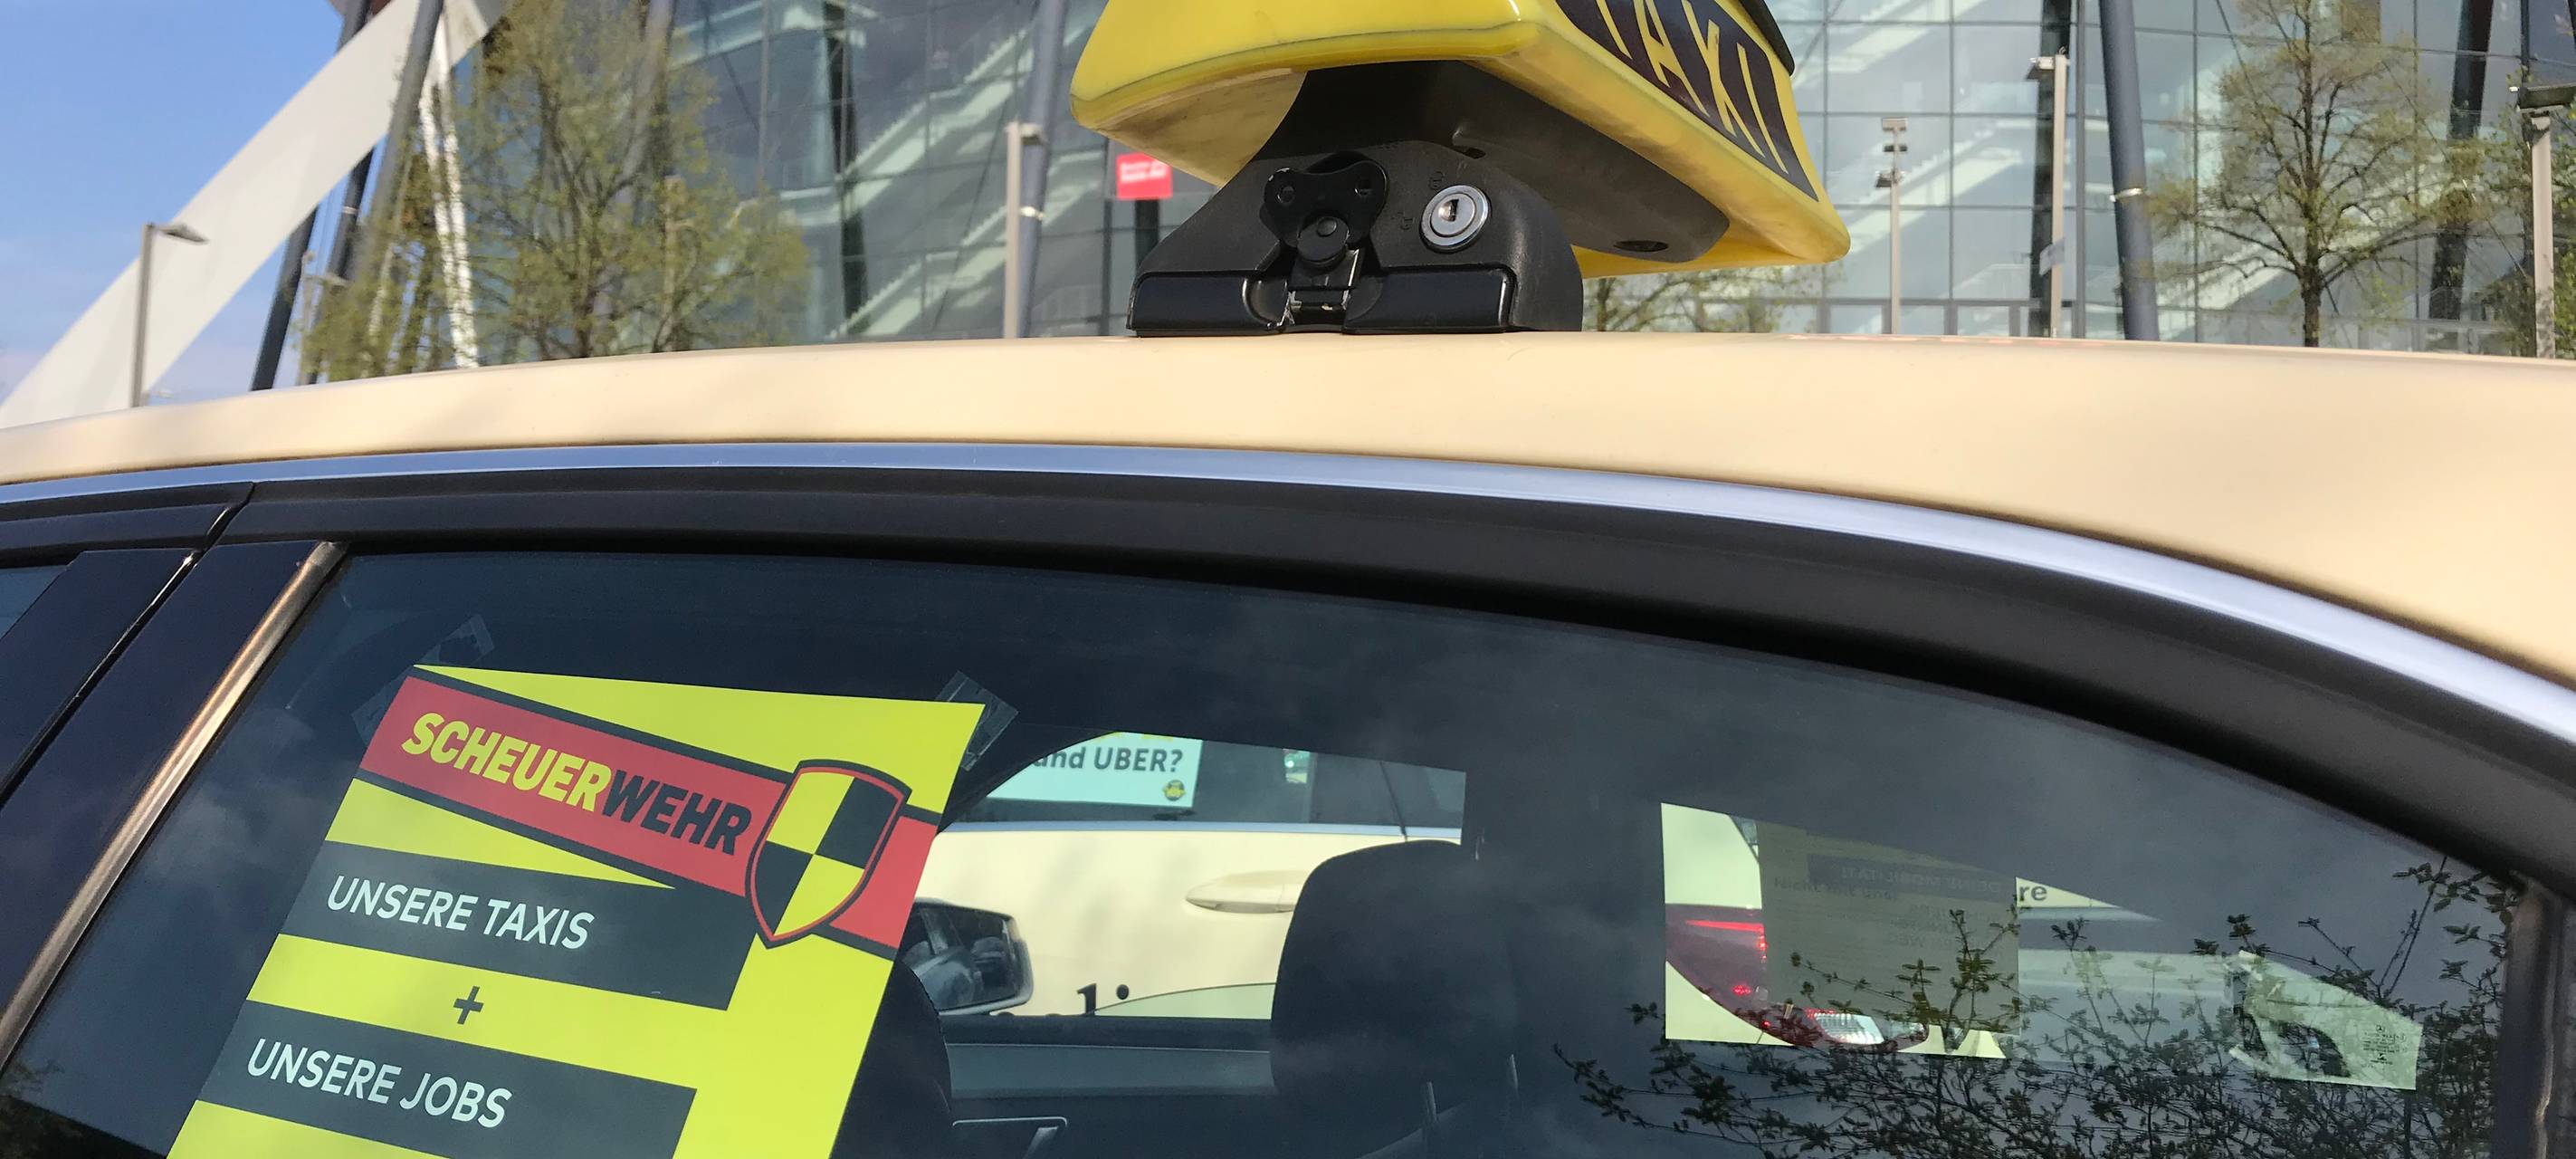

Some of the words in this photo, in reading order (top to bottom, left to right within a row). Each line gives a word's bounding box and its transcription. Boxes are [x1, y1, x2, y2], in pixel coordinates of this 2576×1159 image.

[401, 712, 752, 856] SCHEUERWEHR
[1093, 746, 1184, 772] UBER?
[327, 875, 479, 932] UNSERE
[482, 898, 596, 950] TAXIS
[247, 1038, 402, 1105] UNSERE
[398, 1072, 513, 1128] JOBS
